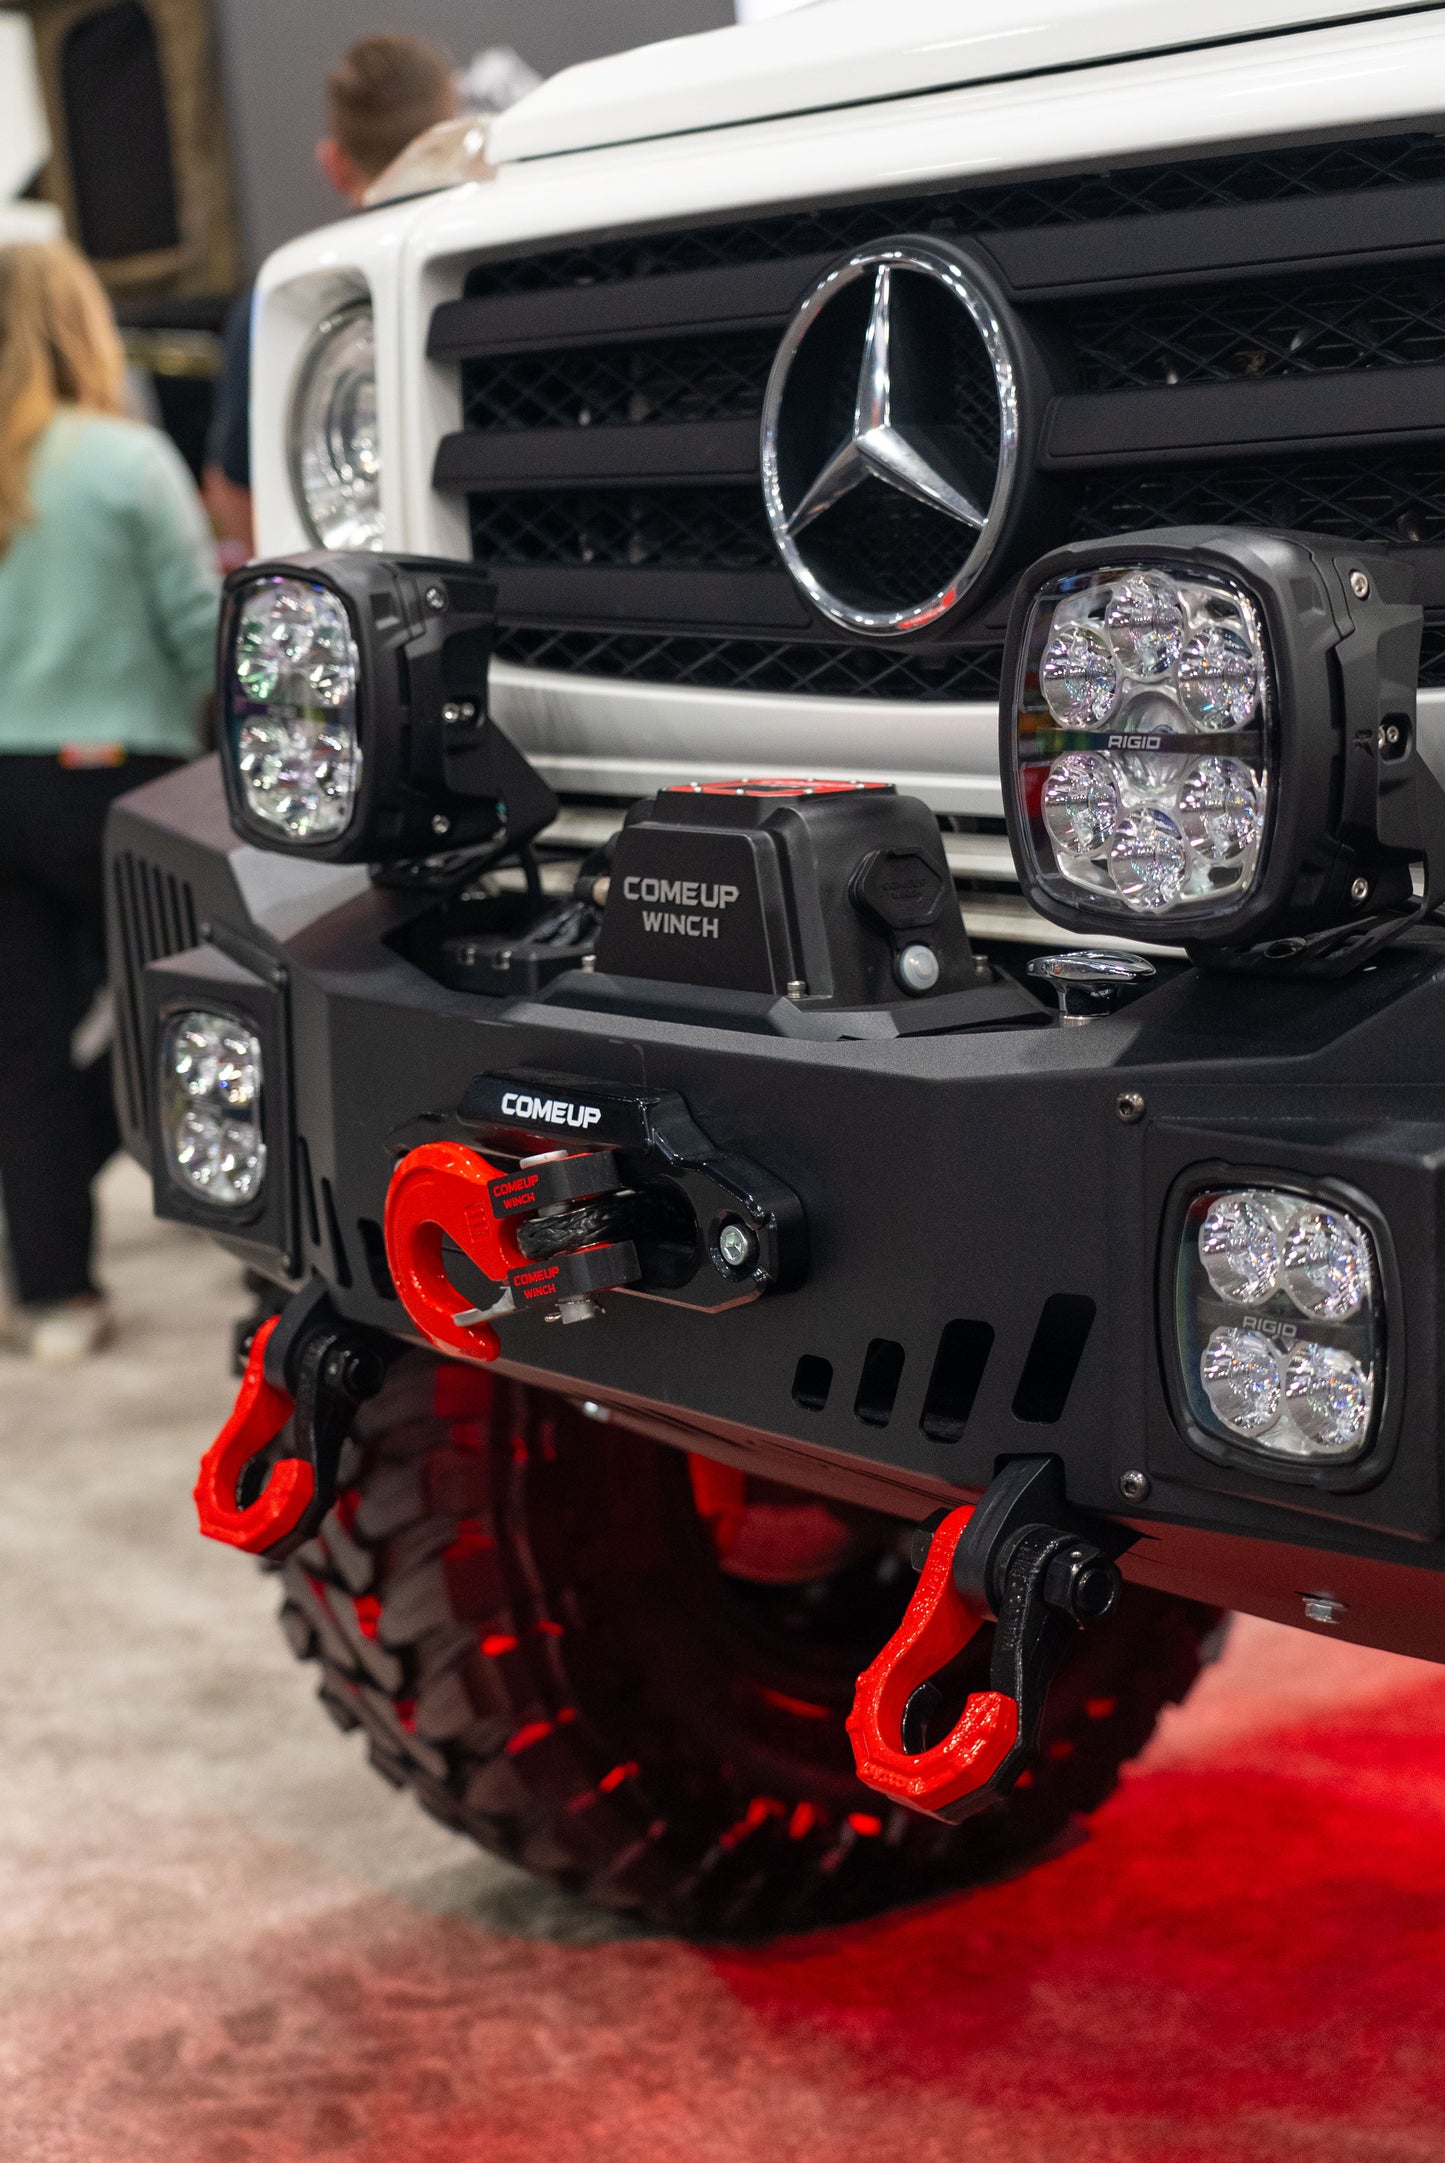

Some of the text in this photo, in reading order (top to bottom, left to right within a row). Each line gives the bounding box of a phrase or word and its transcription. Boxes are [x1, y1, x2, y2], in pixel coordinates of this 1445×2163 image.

[1107, 735, 1161, 750] RIGID
[623, 876, 740, 909] COMEUP
[642, 910, 719, 939] WINCH
[501, 1092, 602, 1129] COMEUP
[493, 1174, 539, 1197] COMEUP
[503, 1193, 535, 1209] WINCH
[513, 1265, 559, 1287] COMEUP
[523, 1283, 556, 1299] WINCH
[1242, 1315, 1297, 1338] RIGID
